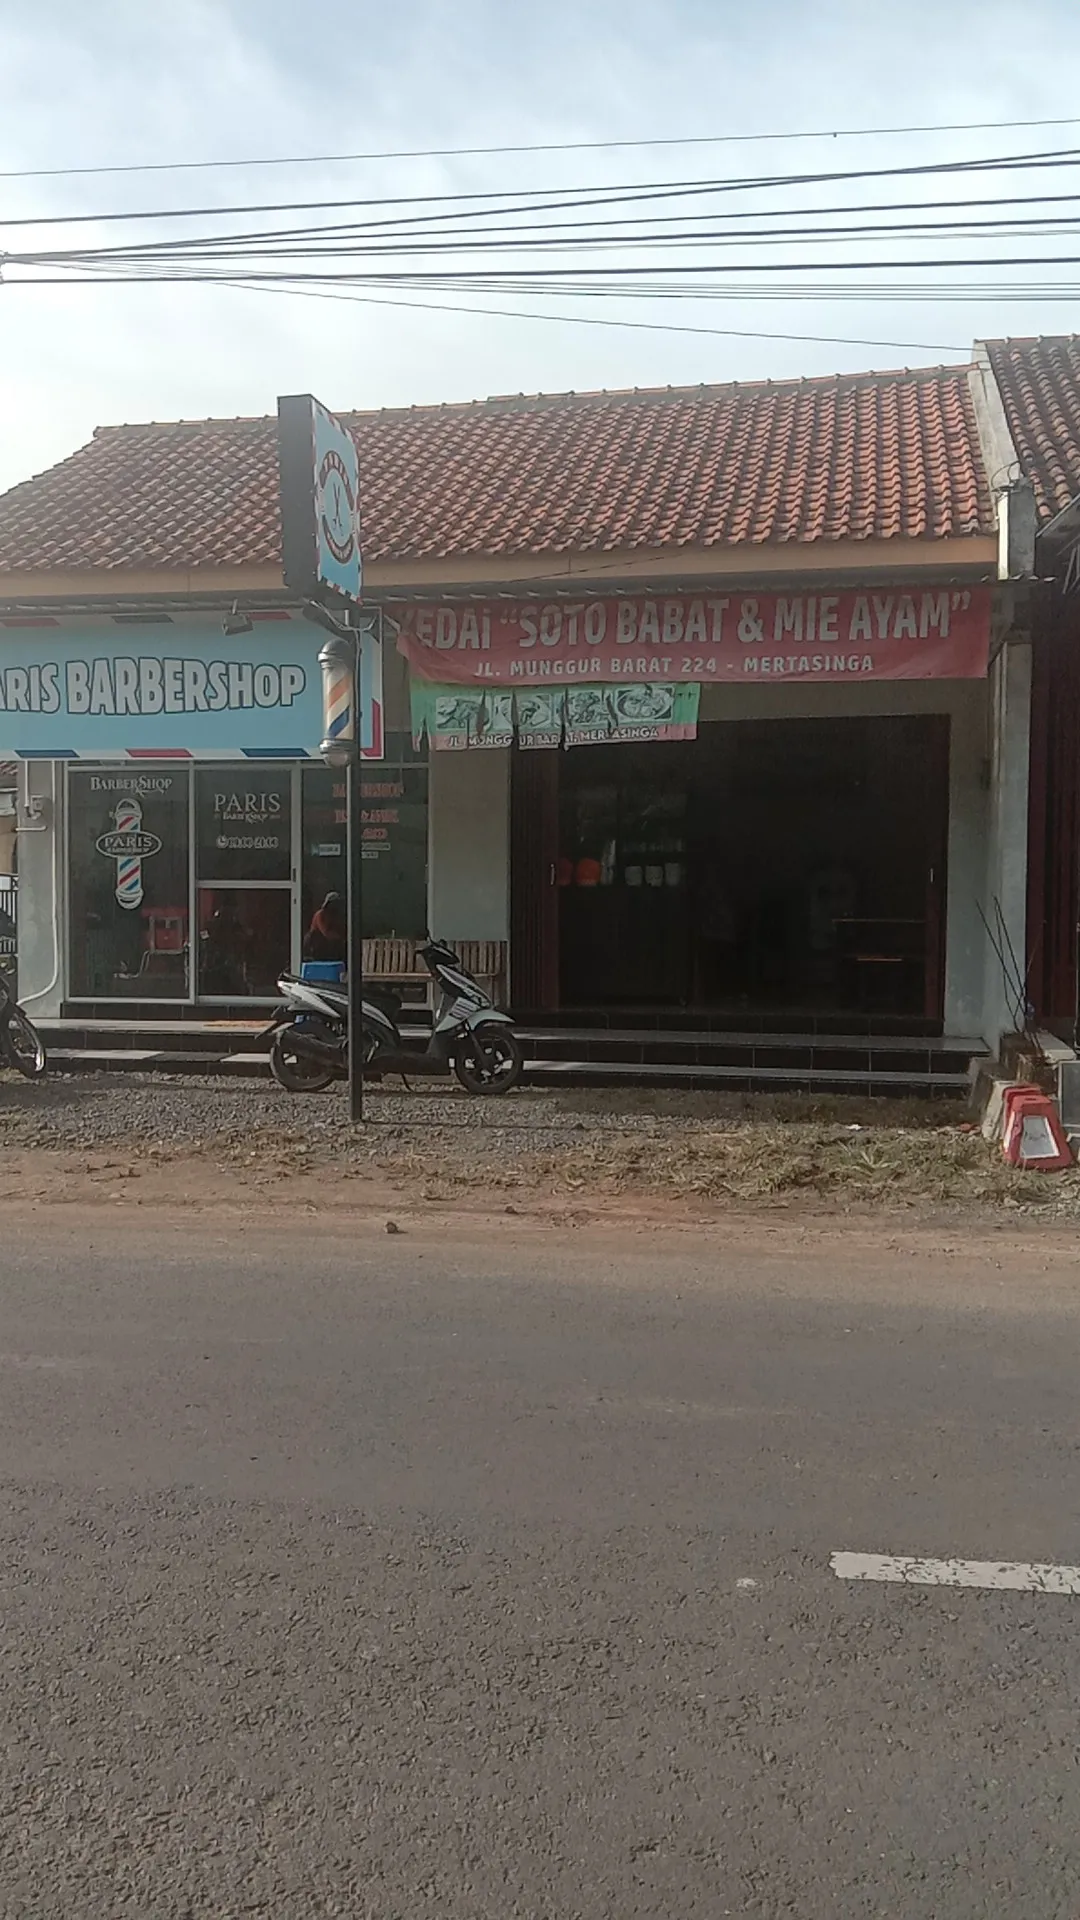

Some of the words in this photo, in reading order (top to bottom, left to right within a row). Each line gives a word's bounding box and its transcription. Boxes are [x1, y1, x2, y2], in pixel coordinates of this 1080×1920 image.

[616, 598, 729, 645] BABAT
[736, 599, 765, 643] &
[774, 596, 838, 641] MIE
[474, 662, 501, 676] JL.
[510, 659, 601, 676] MUNGGUR
[610, 658, 673, 673] BARAT
[681, 657, 717, 673] 224
[744, 655, 873, 673] MERTASINGA
[66, 656, 306, 715] BARBERSHOP
[214, 793, 281, 812] PARIS
[104, 836, 152, 847] PARIS
